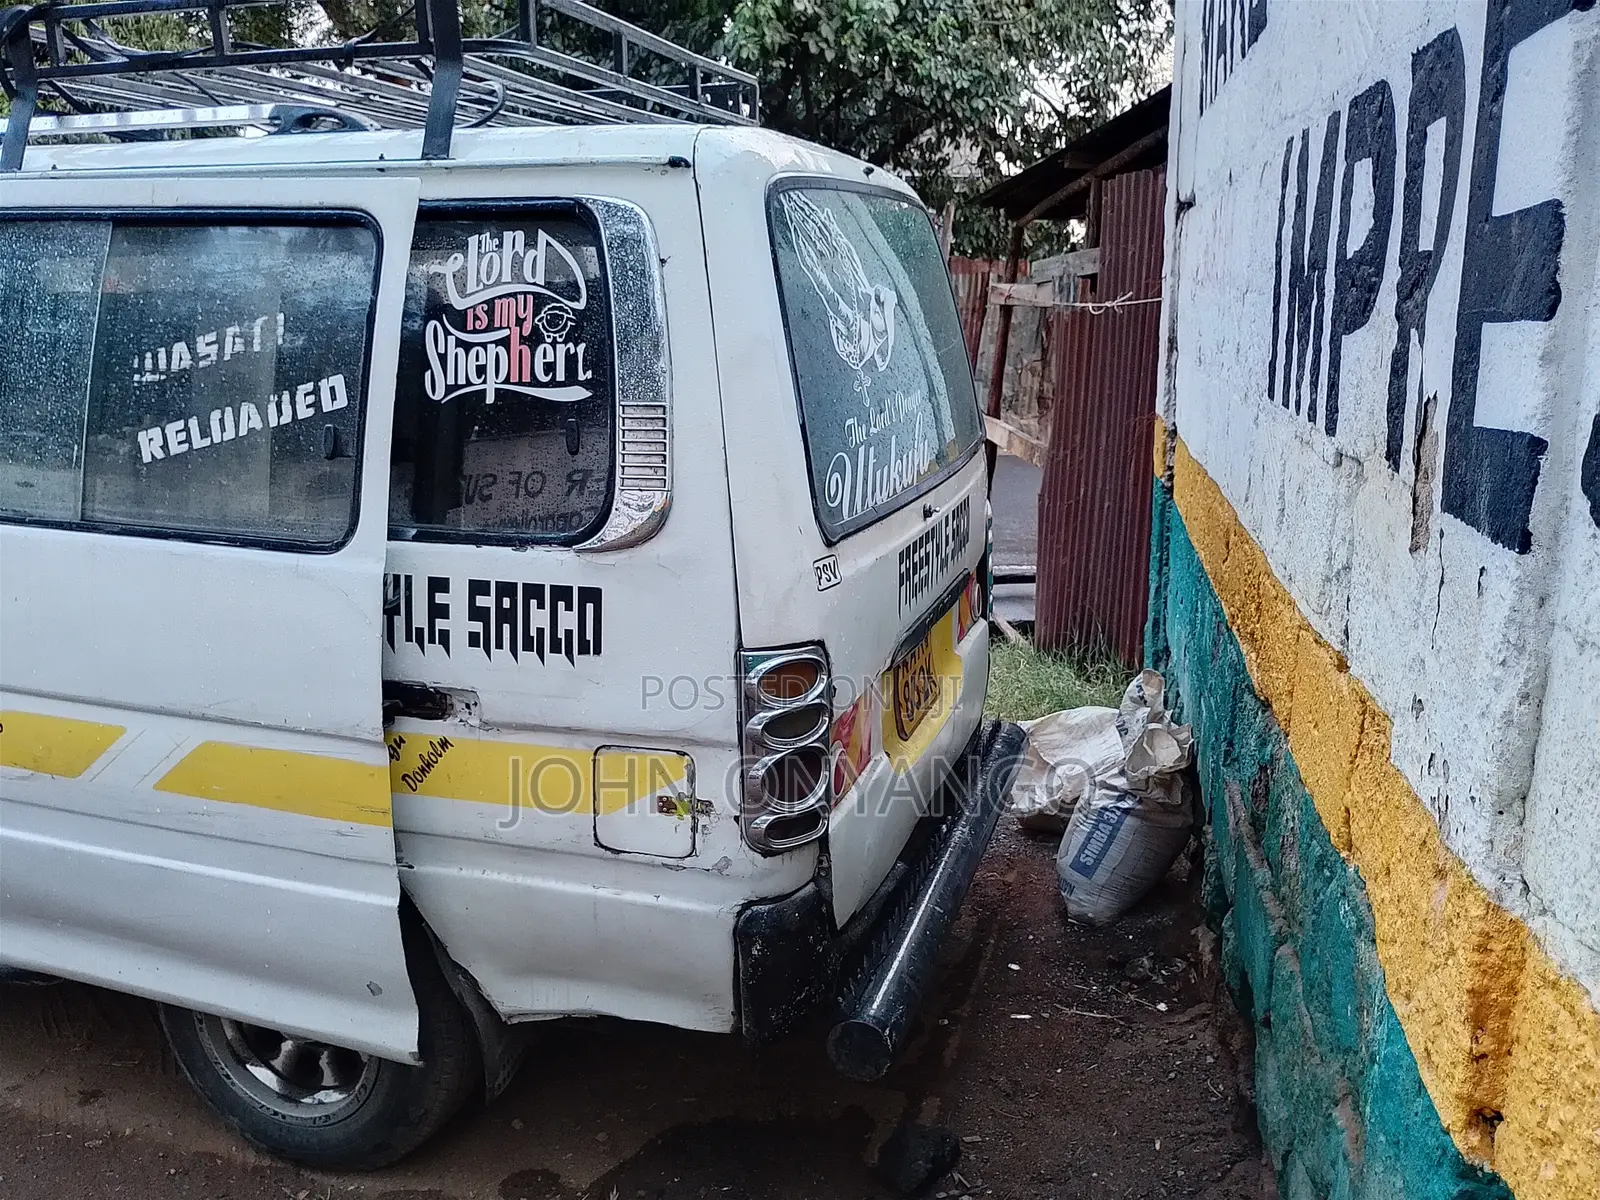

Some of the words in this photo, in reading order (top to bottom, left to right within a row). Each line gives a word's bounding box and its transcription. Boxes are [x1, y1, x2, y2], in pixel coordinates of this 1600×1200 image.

[479, 231, 500, 253] The
[1266, 0, 1600, 556] IMPRE
[466, 303, 489, 331] is
[494, 294, 534, 337] my
[137, 374, 348, 464] RELOADED
[844, 416, 868, 449] The
[869, 406, 898, 437] Lord's
[815, 560, 838, 586] PSV
[898, 513, 950, 620] FREESTYLE
[467, 578, 603, 669] SACCO
[400, 735, 455, 792] Donholm
[1079, 824, 1114, 867] SIMBA
